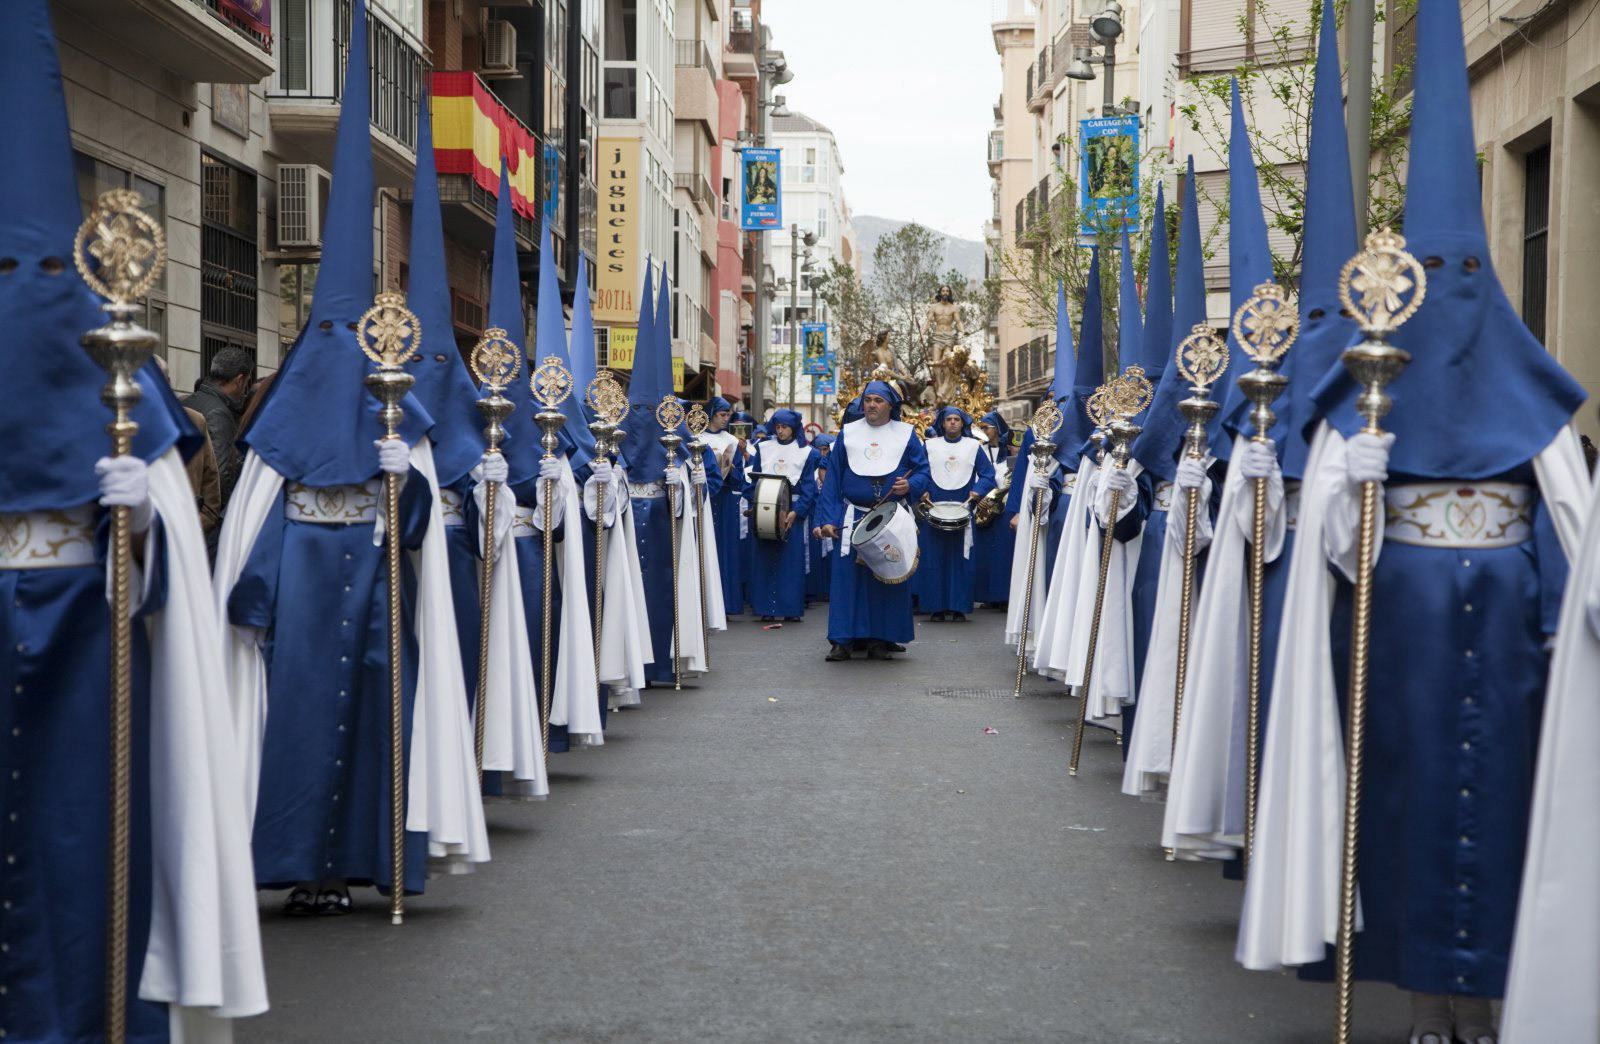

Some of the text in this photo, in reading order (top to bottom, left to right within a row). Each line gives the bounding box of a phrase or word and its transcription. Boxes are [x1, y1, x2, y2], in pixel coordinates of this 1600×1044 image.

[1088, 118, 1132, 127] CARTAGENA
[608, 148, 626, 273] juguetes
[597, 288, 632, 311] BOTIA
[613, 332, 636, 343] jugue
[612, 348, 633, 362] BOT
